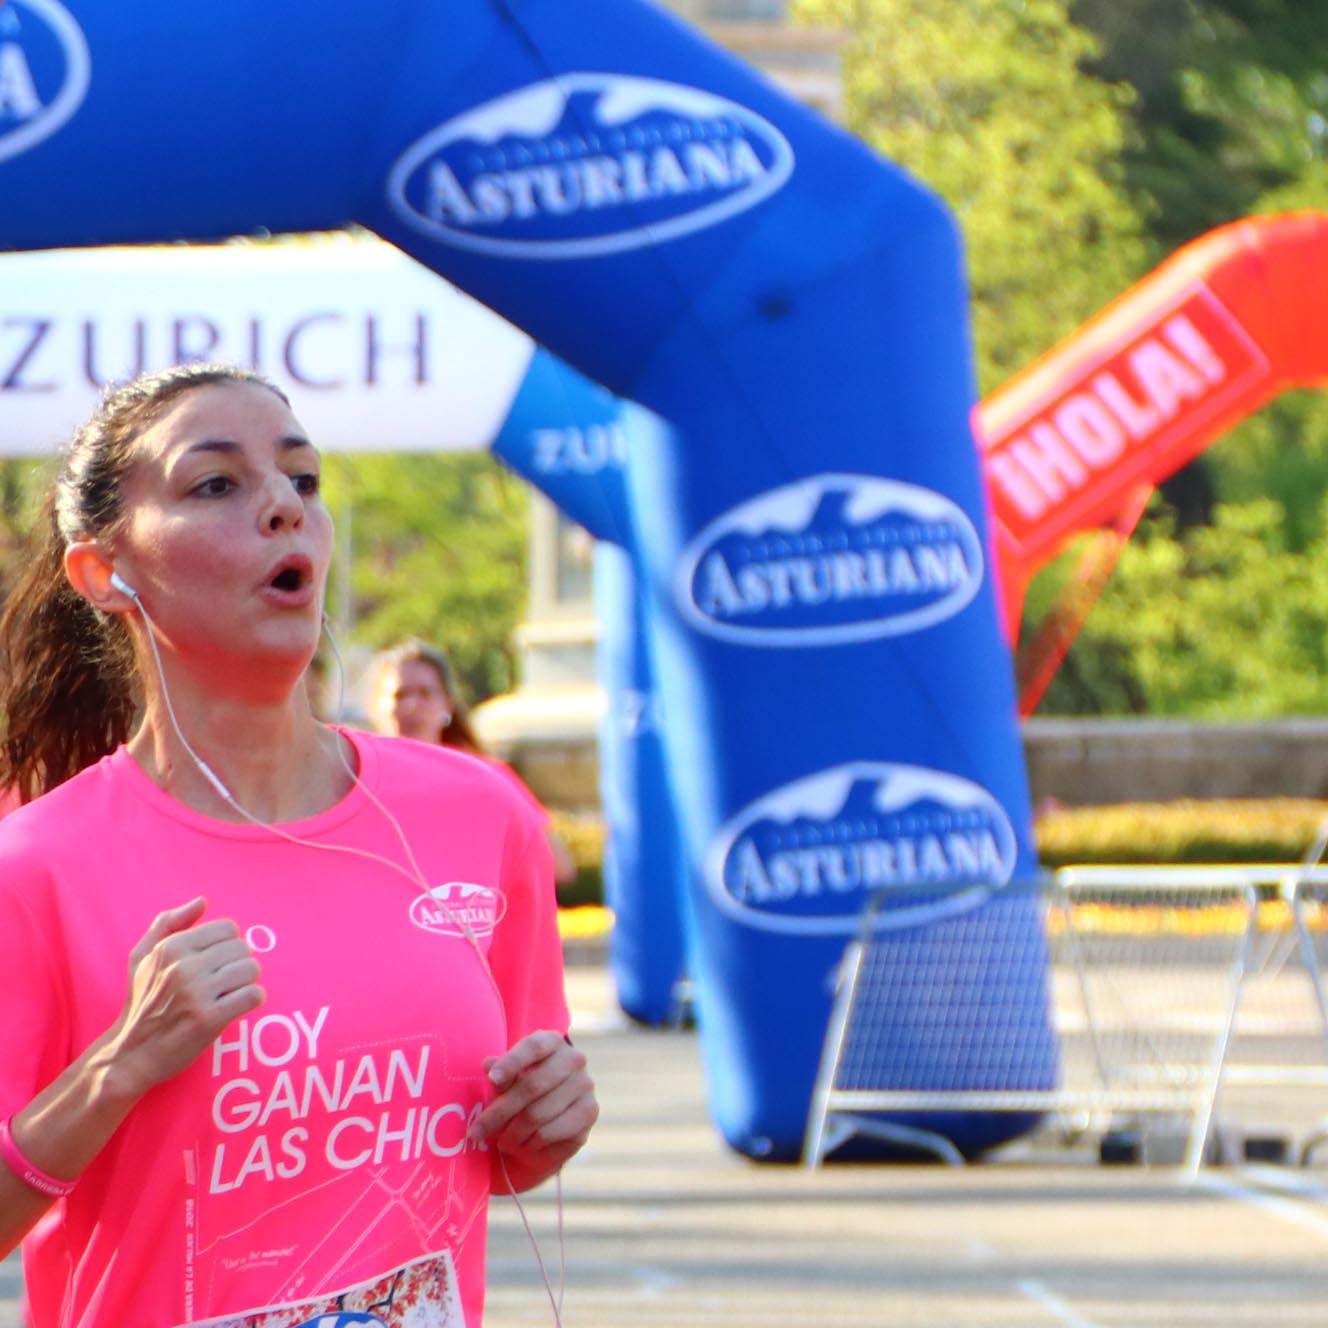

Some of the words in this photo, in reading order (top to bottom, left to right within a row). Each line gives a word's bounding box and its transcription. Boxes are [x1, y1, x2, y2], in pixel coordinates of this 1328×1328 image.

[424, 138, 768, 225] ASTURIANA
[698, 542, 971, 617] ASTURIANA
[736, 830, 1004, 903] ASTURIANA
[211, 1006, 330, 1077] HOY
[212, 1046, 430, 1133] GANAN
[209, 1126, 309, 1195] LAS
